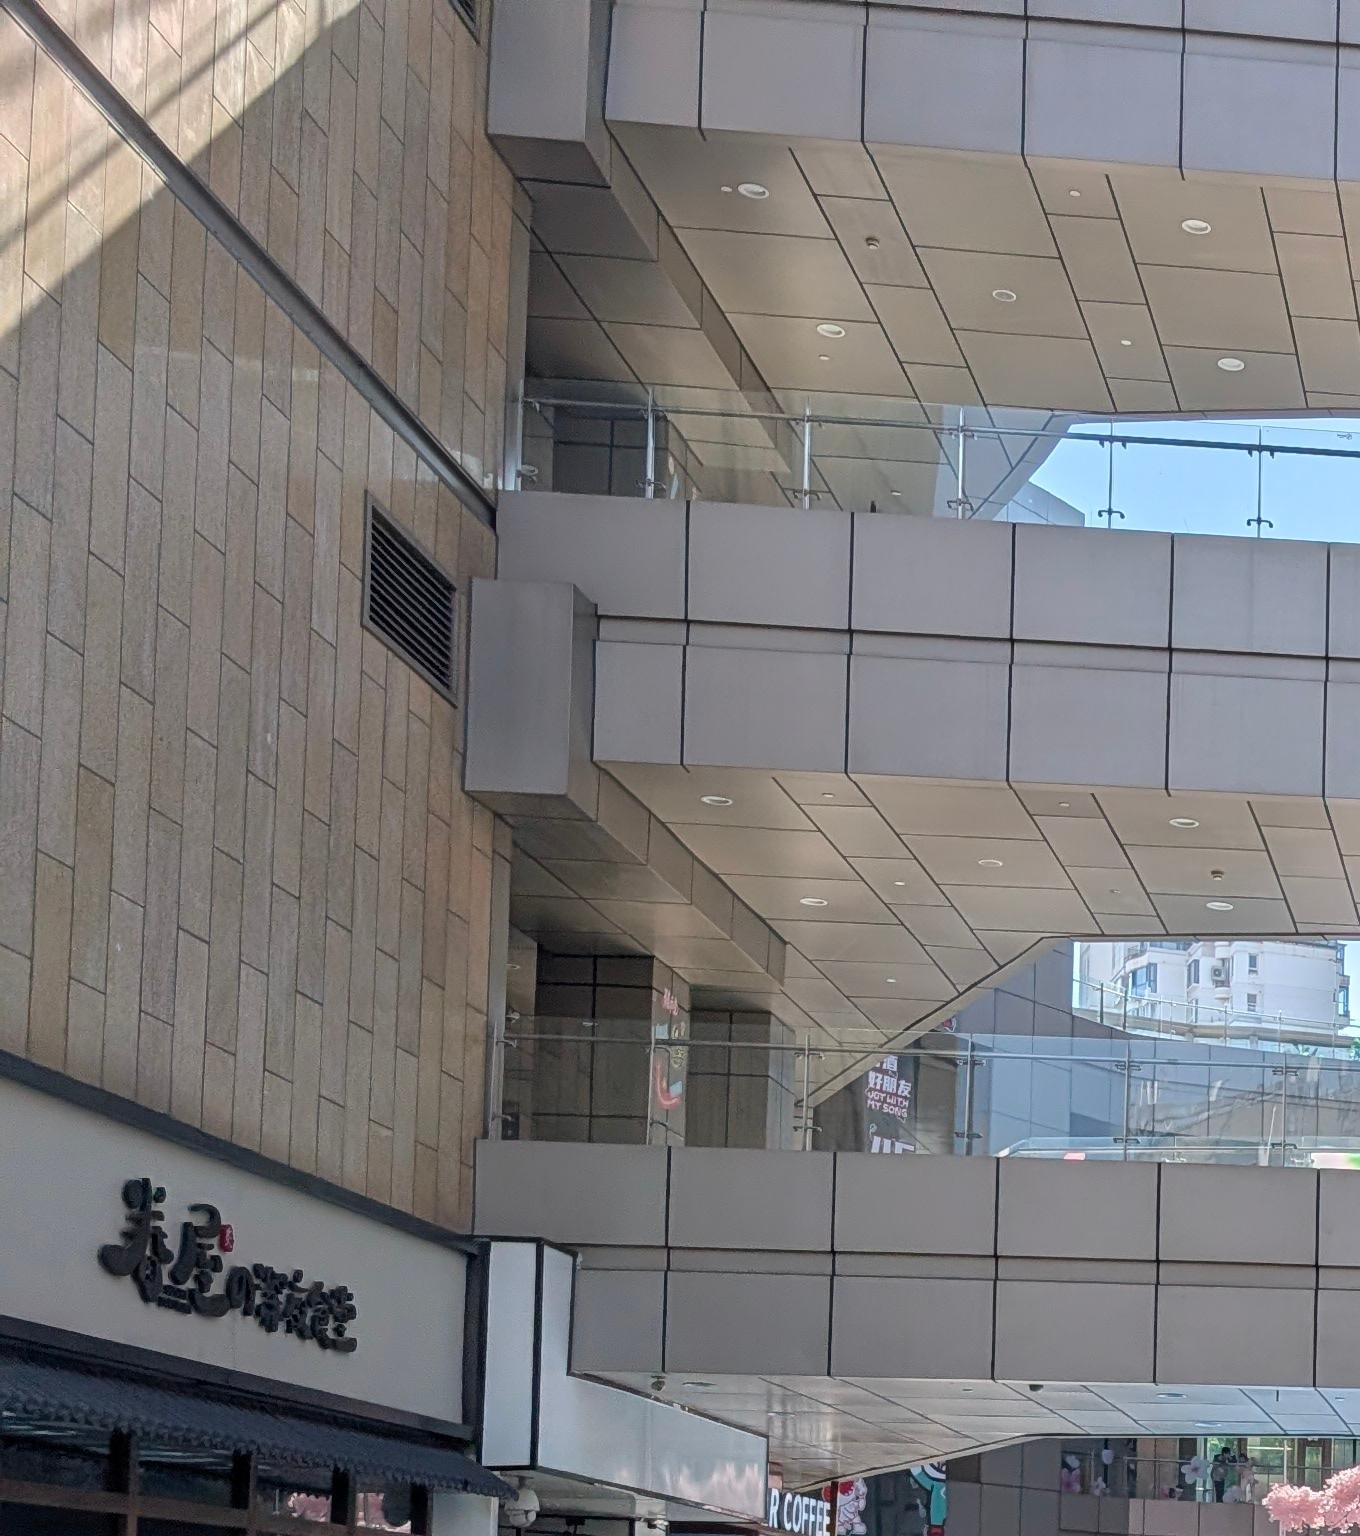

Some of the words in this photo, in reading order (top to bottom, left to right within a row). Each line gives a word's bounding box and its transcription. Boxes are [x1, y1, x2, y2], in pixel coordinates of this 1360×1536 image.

[868, 1070, 911, 1098] 好朋友
[882, 1103, 908, 1118] SONG
